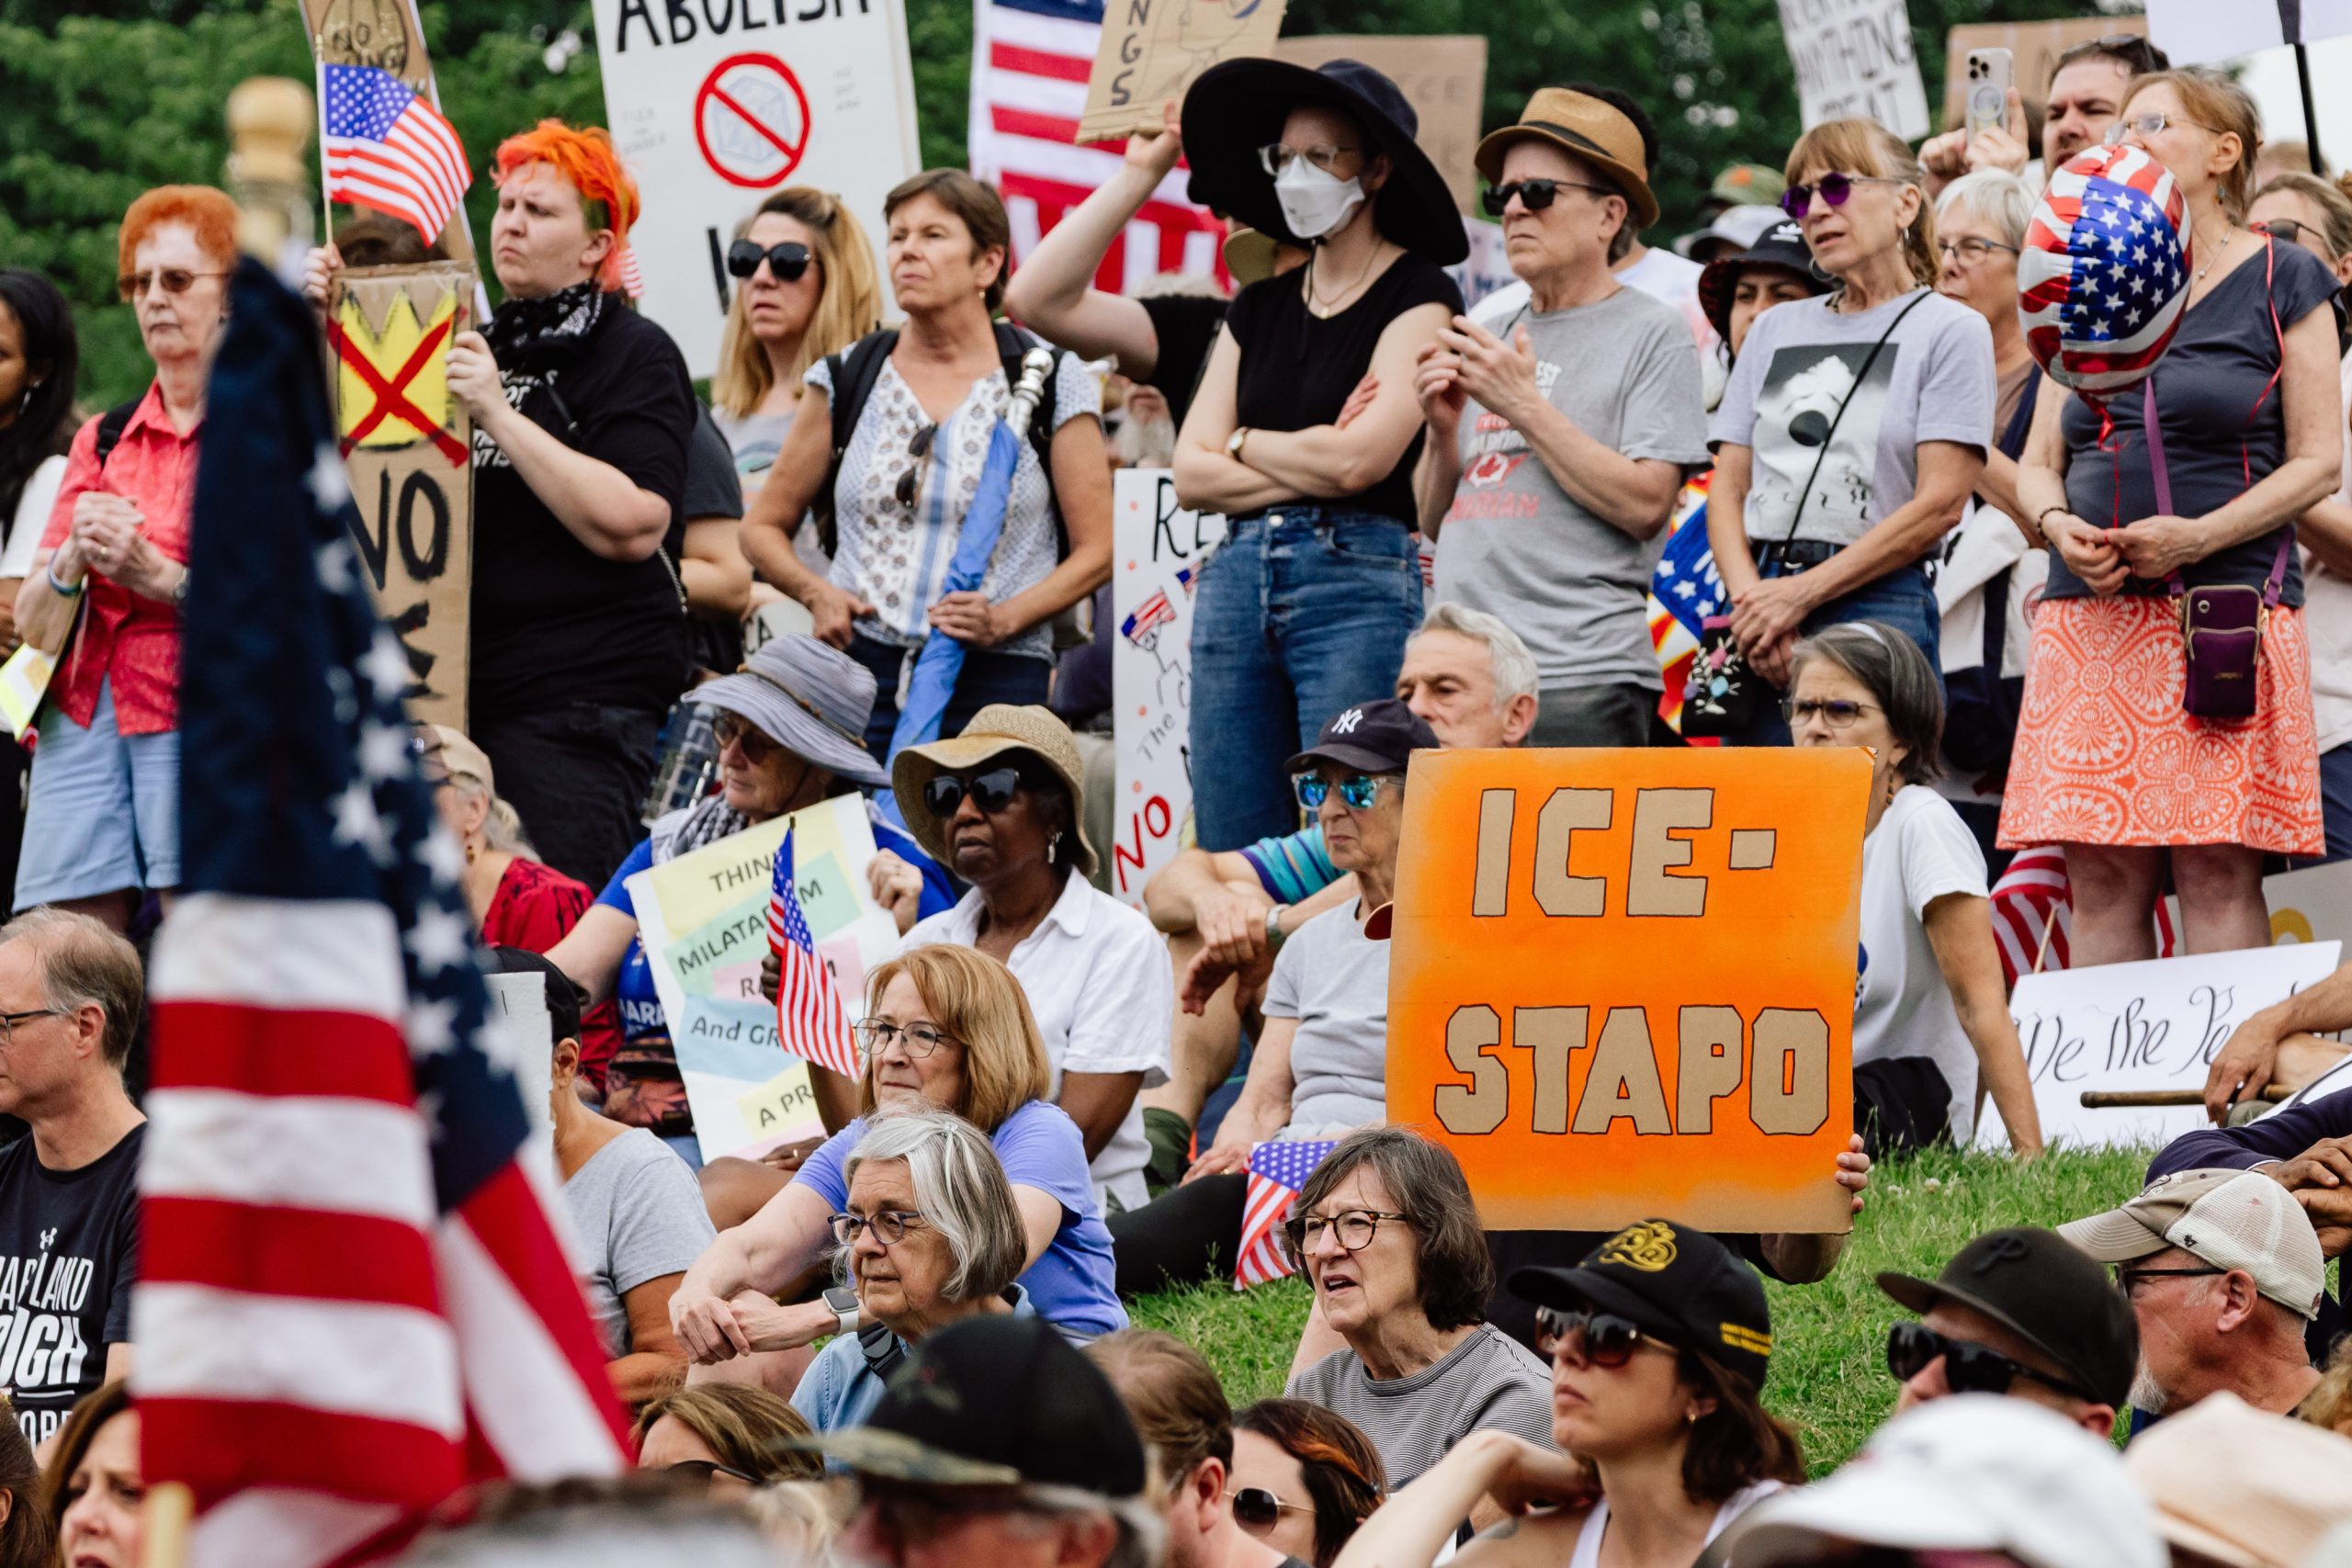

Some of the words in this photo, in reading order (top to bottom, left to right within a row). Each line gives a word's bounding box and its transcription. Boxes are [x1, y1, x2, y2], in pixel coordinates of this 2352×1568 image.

[709, 851, 775, 893] THIN
[1114, 795, 1171, 892] NO
[1472, 786, 1778, 918] ICE-
[677, 879, 823, 976] MILATAM
[691, 1015, 741, 1042] And
[1433, 1003, 1830, 1136] STAPO
[759, 1107, 776, 1128] A
